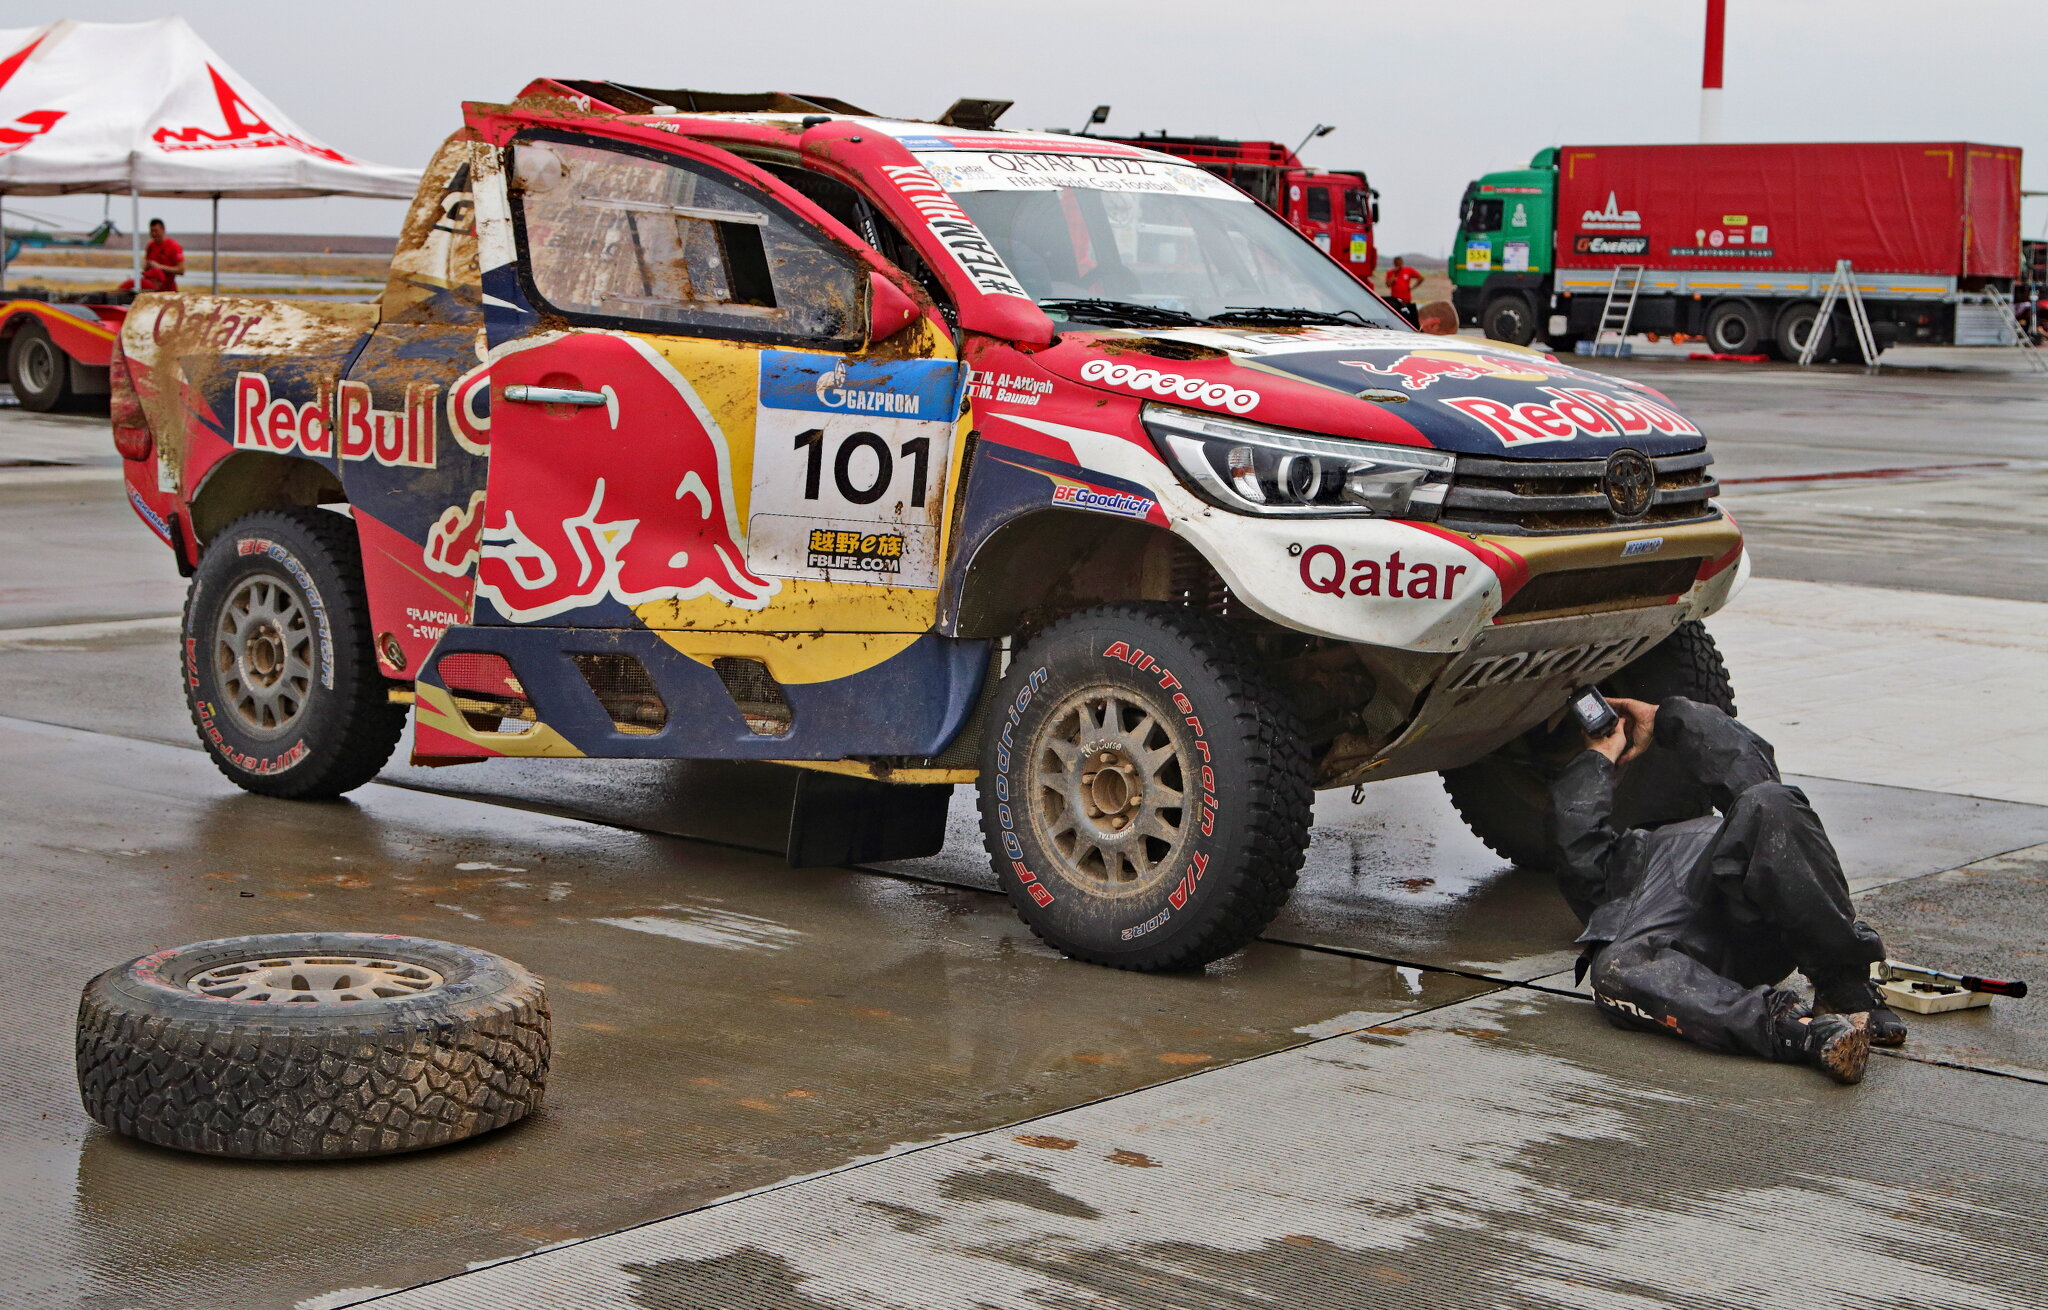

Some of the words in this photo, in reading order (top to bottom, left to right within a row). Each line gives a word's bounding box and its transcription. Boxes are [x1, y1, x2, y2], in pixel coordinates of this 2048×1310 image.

[988, 154, 1086, 174] QATAR
[1083, 156, 1155, 176] 2022
[1089, 177, 1122, 190] Cup
[1121, 179, 1179, 191] Football
[152, 300, 262, 349] Qatar
[847, 391, 920, 414] GAZPROM
[979, 386, 993, 399] M.
[996, 388, 1040, 405] Baumel
[983, 371, 994, 385] N.
[996, 373, 1054, 394] Al-Attiyah
[1084, 361, 1257, 410] ooredoo
[235, 373, 333, 457] Red
[339, 380, 438, 466] Bull
[1444, 388, 1618, 446] Red
[1567, 388, 1700, 436] Bull
[794, 428, 930, 508] 101
[1053, 486, 1152, 513] BFGoodrich
[808, 553, 900, 573] FBLIFE.COM
[809, 530, 903, 556] 越野e族
[1300, 544, 1467, 600] Qatar
[1443, 636, 1650, 692] TOYOTA
[1103, 641, 1219, 837] All-Terrain
[995, 666, 1056, 908] BFGoodrich
[1168, 849, 1209, 910] T/A
